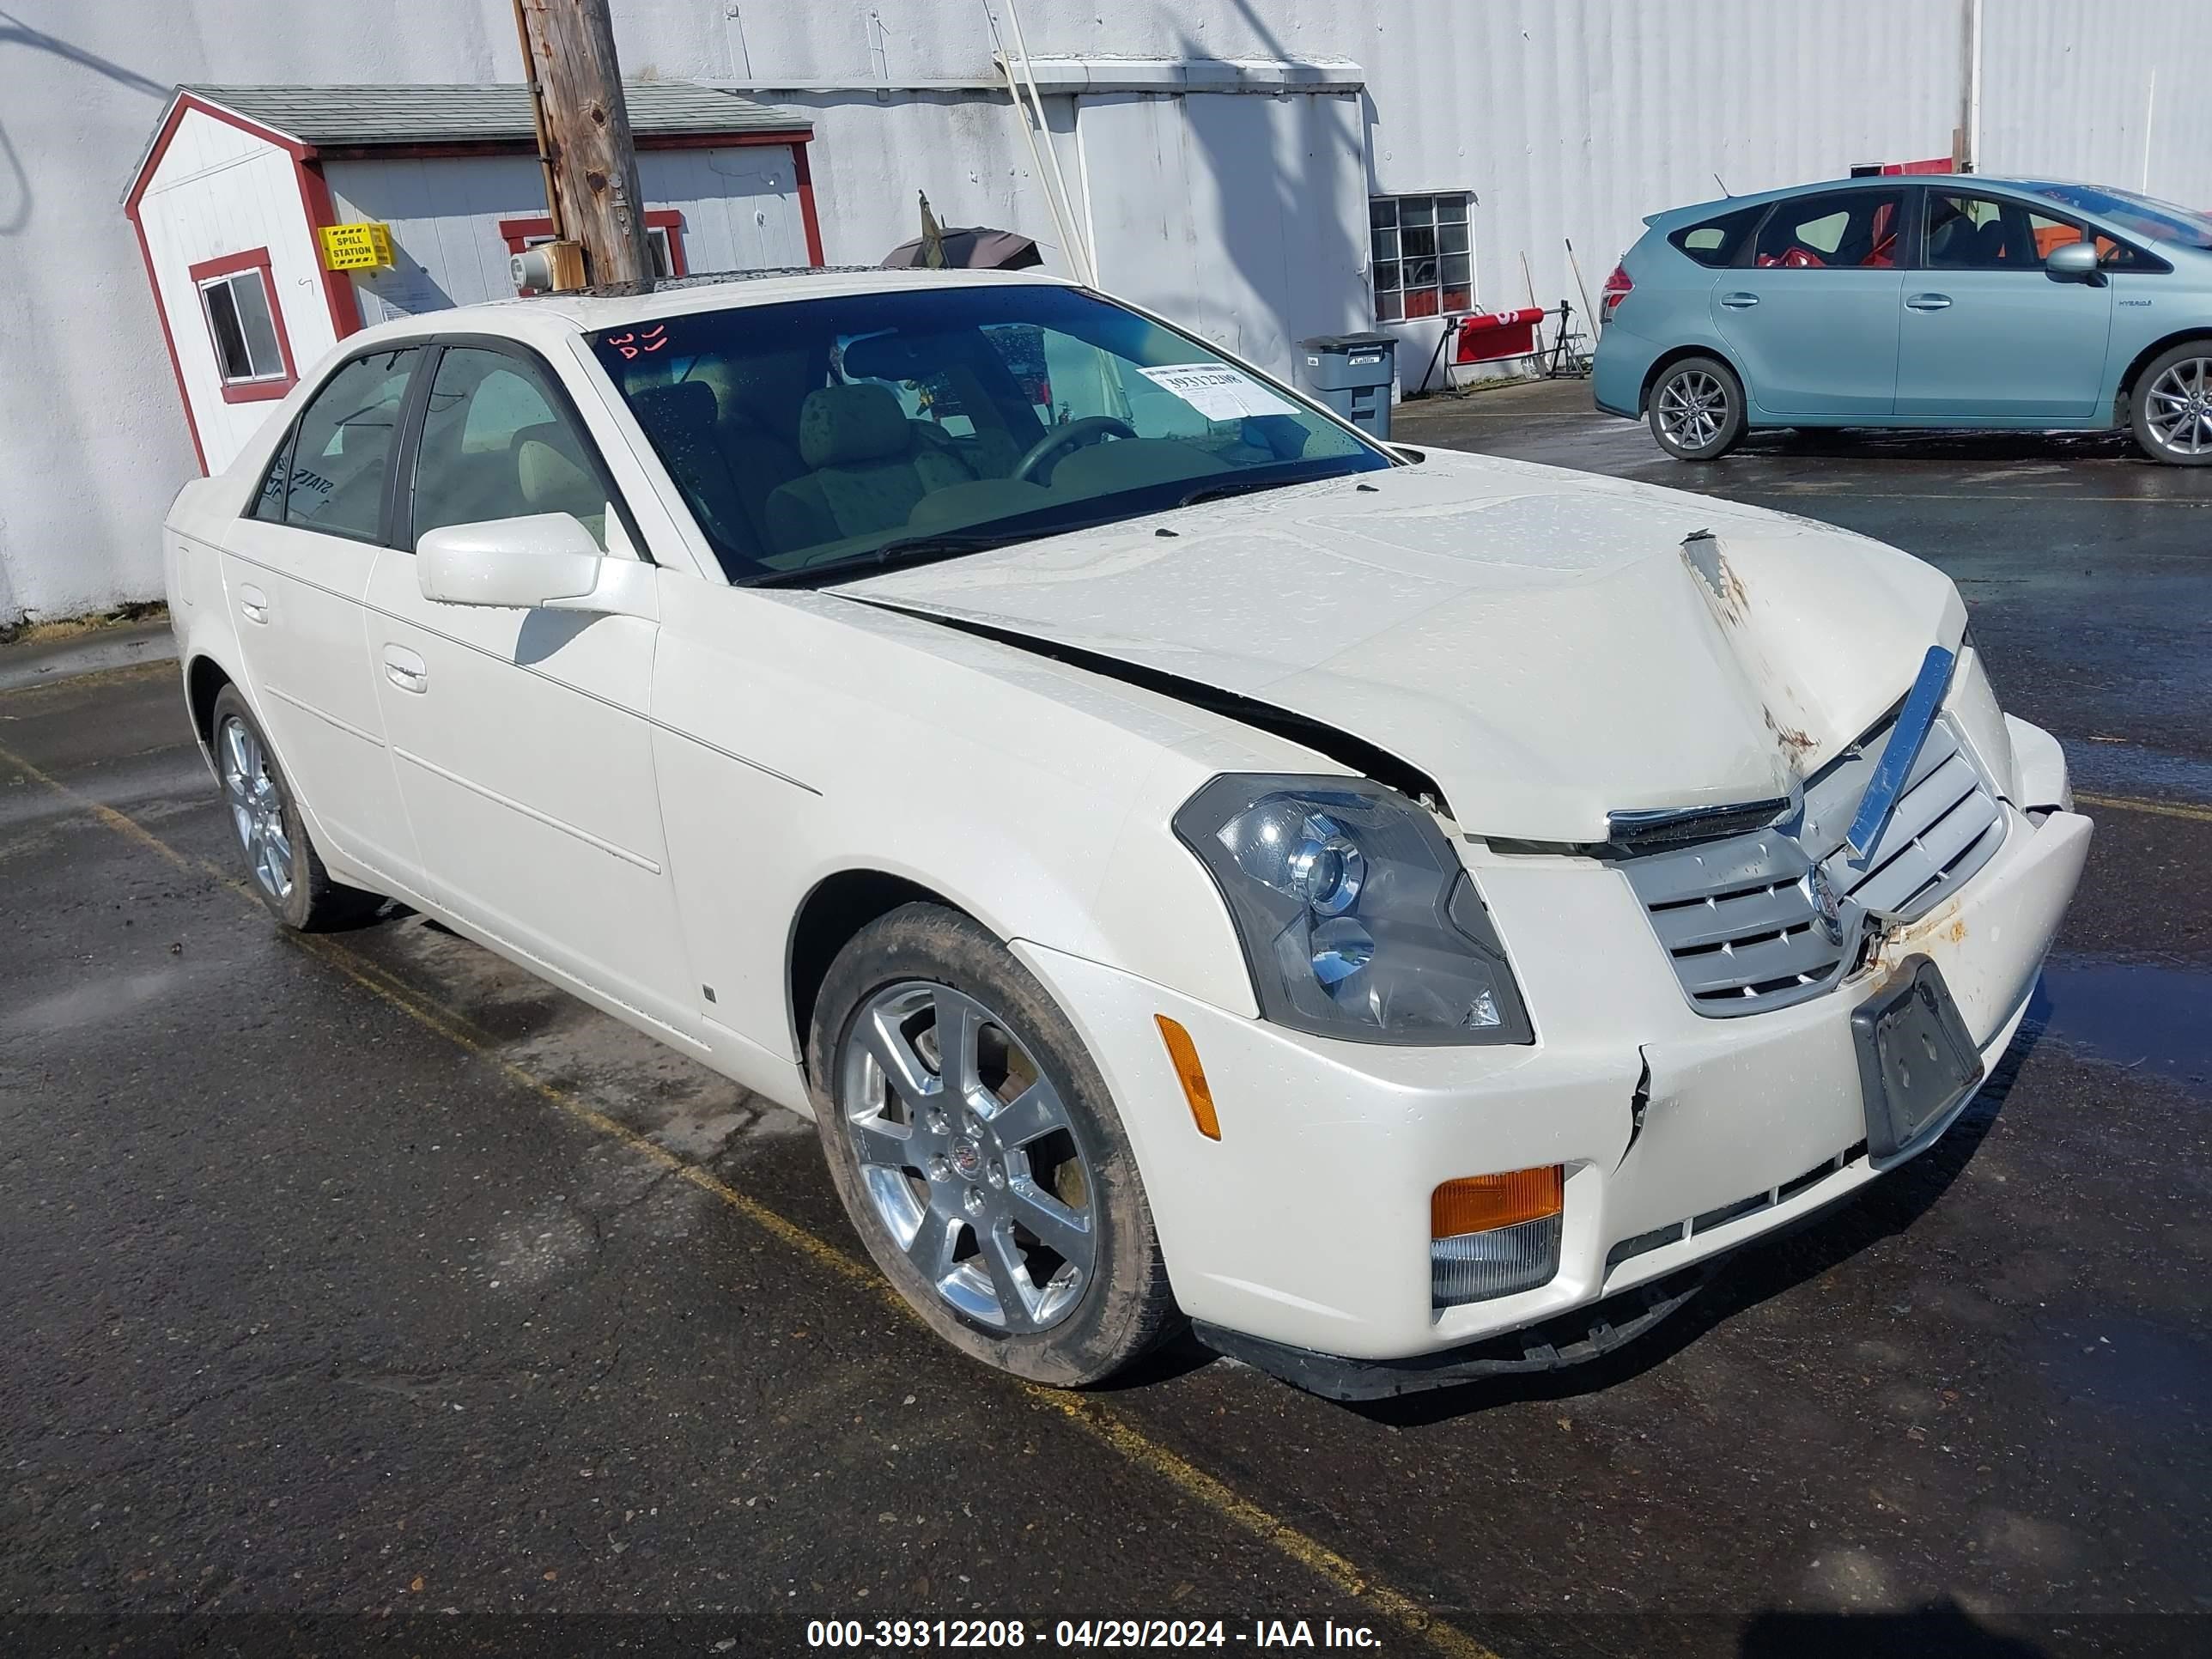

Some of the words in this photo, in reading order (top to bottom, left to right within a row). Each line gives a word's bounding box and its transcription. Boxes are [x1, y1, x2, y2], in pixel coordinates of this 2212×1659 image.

[336, 236, 363, 246] SPILL
[333, 246, 371, 258] STATION
[1165, 374, 1243, 389] 39312208
